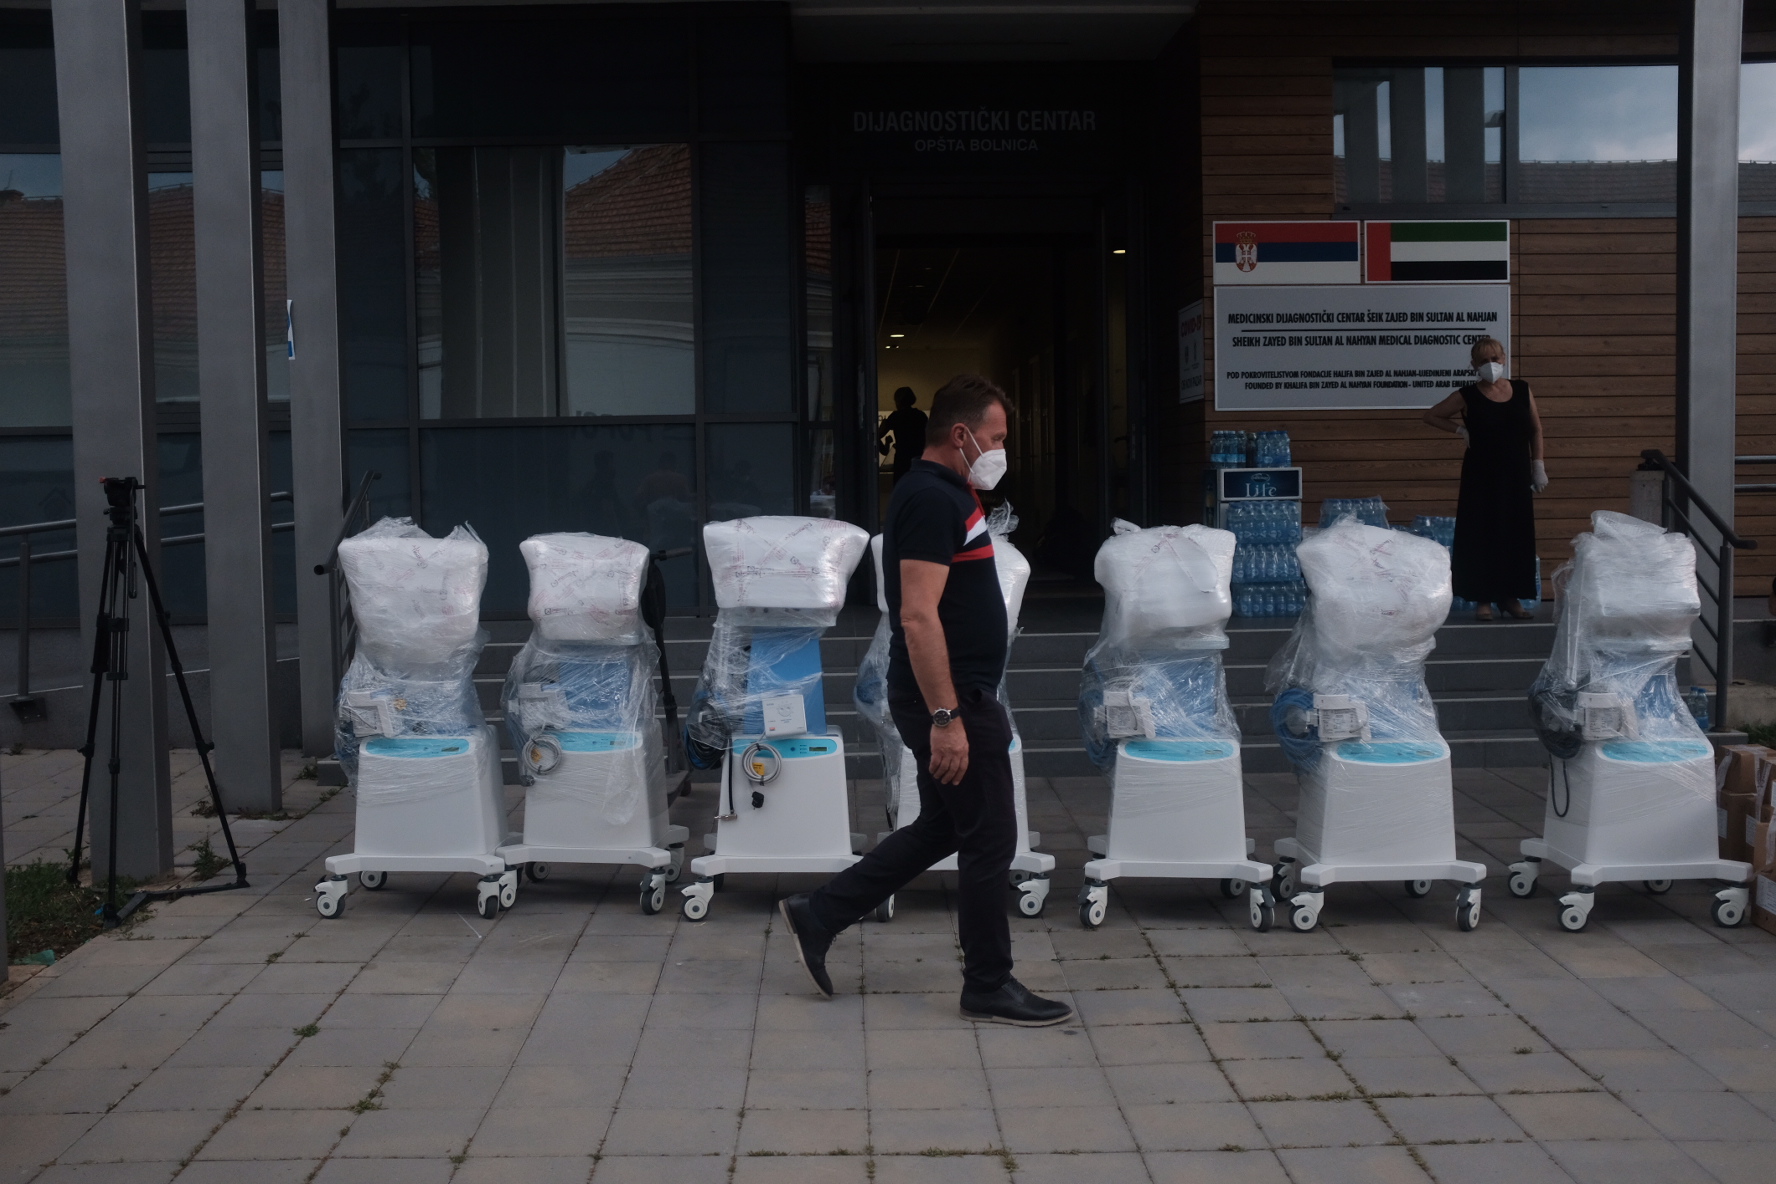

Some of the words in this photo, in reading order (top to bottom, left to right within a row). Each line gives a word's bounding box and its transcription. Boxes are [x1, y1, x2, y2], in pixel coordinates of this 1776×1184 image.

[853, 105, 1010, 132] DIJAGNOSTIČKI
[1017, 109, 1097, 131] CENTAR
[914, 135, 966, 152] OPŠTA
[969, 138, 1039, 151] BOLNICA
[1227, 312, 1274, 324] MEDICINSKI
[1275, 309, 1335, 323] DIJAGNOSTIČKI
[1336, 312, 1366, 323] CENTAR
[1366, 309, 1384, 323] ŠEIK
[1385, 311, 1408, 322] ZAJED
[1409, 311, 1425, 322] BIN
[1425, 311, 1455, 322] SULTAN
[1455, 311, 1466, 322] AL
[1466, 311, 1498, 322] NAHJAN
[1181, 314, 1202, 338] COVID-19
[1232, 336, 1261, 347] SHEIKH
[1262, 336, 1287, 347] ZAYED
[1288, 336, 1303, 346] BIN
[1304, 335, 1333, 346] SULTAN
[1334, 335, 1345, 346] AL
[1345, 335, 1377, 346] NAHYAN
[1378, 334, 1413, 346] MEDICAL
[1413, 334, 1461, 345] DIAGNOSTIC
[1226, 371, 1240, 379] POD
[1300, 370, 1332, 378] FONDACIJE
[1332, 370, 1354, 378] HALIFA
[1354, 370, 1366, 378] BIN
[1366, 370, 1384, 378] ZAJED
[1384, 369, 1394, 377] AL
[1244, 382, 1274, 390] FOUNDED
[1274, 382, 1283, 390] BY
[1283, 381, 1309, 389] KHALIFA
[1309, 381, 1321, 389] BIN
[1321, 381, 1340, 389] ZAYED
[1340, 381, 1349, 389] AL
[1348, 381, 1373, 389] NAHYAN
[1373, 380, 1408, 388] FOUNDATION
[1412, 380, 1436, 388] UNITED
[1435, 380, 1452, 388] ARAB
[1246, 482, 1277, 498] Life
